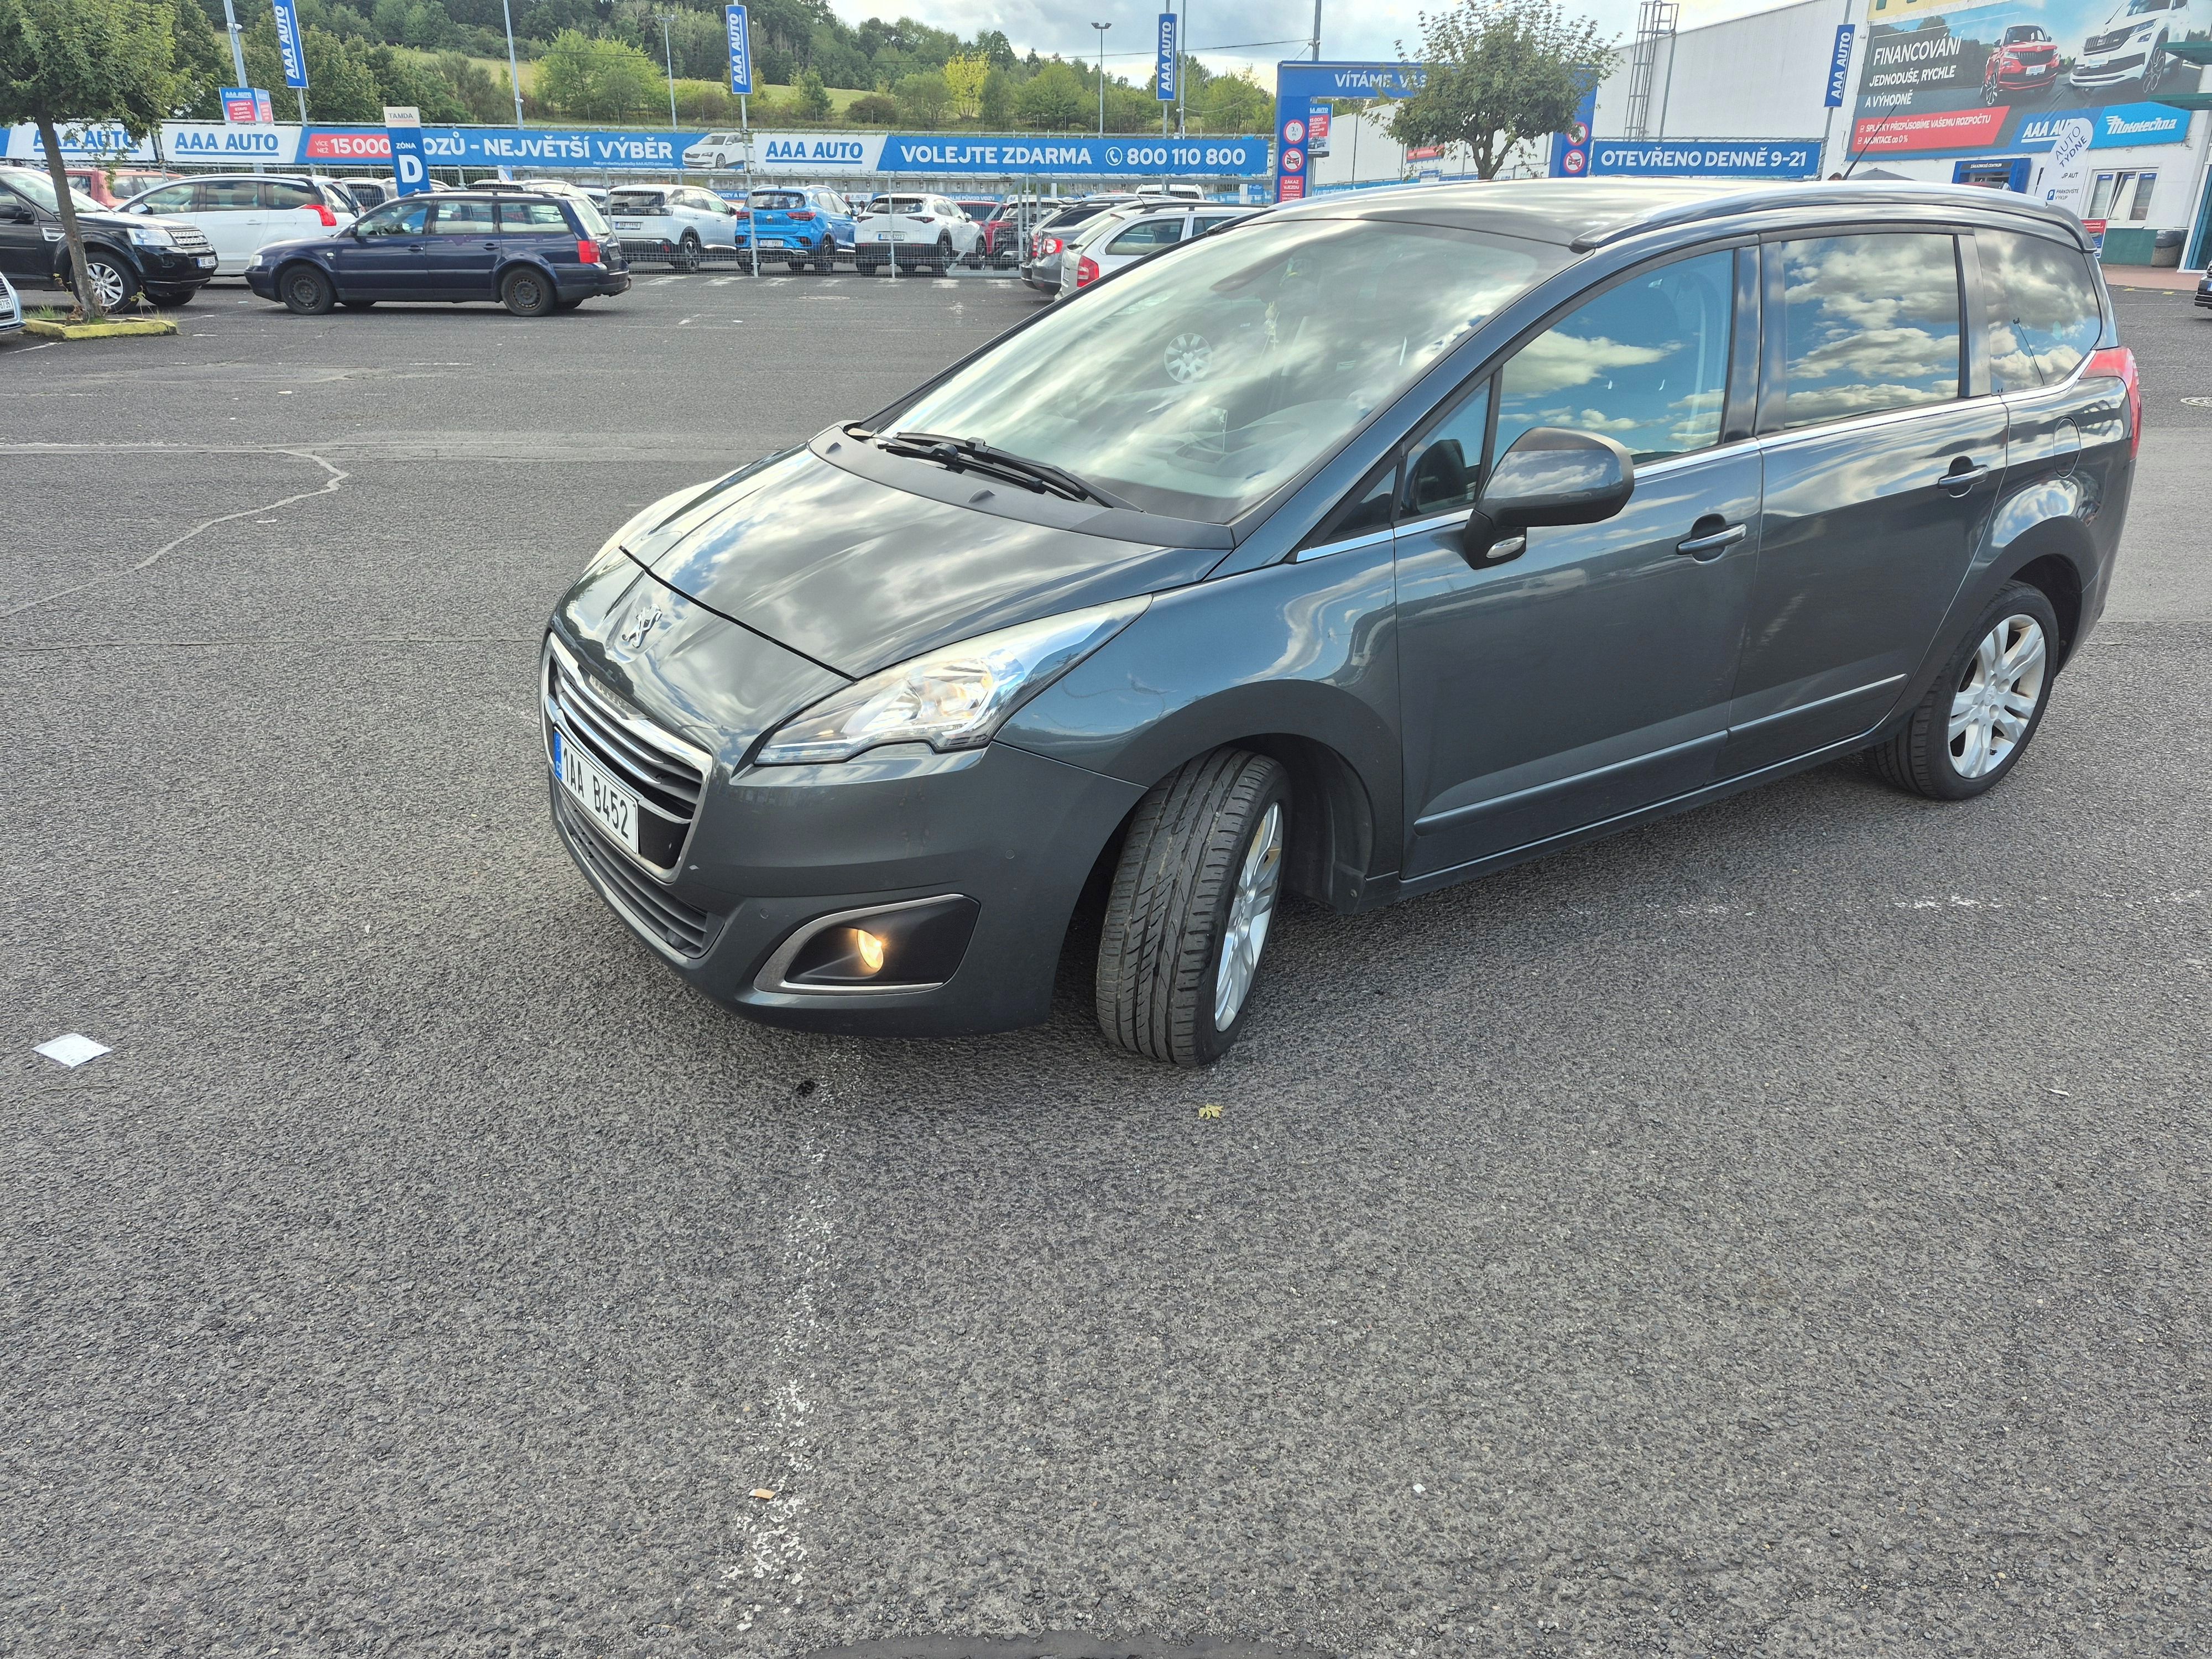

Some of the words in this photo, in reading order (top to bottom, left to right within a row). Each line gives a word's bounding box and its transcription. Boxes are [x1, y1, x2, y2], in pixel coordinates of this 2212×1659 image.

[275, 6, 290, 44] AUTO
[729, 13, 741, 51] AUTO
[1162, 22, 1171, 58] AUTO
[1837, 32, 1850, 67] AUTO
[283, 48, 296, 79] AAA
[732, 55, 744, 85] AAA
[1161, 62, 1171, 91] AAA
[1869, 67, 1919, 87] JEDNODUŠE,
[1921, 65, 1957, 81] RYCHLE
[1334, 71, 1392, 88] VÍTÁME
[1832, 71, 1844, 98] AAA
[1865, 96, 1871, 108] A
[1873, 89, 1913, 107] VÝHODNĚ
[1931, 117, 1956, 128] VAŠEMU
[1956, 113, 1991, 126] ROZPOČTU
[2022, 120, 2049, 138] AAA
[2106, 116, 2177, 135] Mototechna
[175, 132, 218, 150] AAA
[225, 133, 279, 151] AUTO
[422, 131, 465, 155] OZŮ
[484, 135, 590, 158] NEJVĚTŠÍ
[597, 137, 673, 159] VÝBĚR
[766, 142, 807, 157] AAA
[813, 142, 863, 159] AUTO
[900, 145, 998, 164] VOLEJTE
[1002, 147, 1092, 165] ZDARMA
[1128, 147, 1167, 165] 800
[1172, 148, 1202, 165] 110
[1205, 148, 1246, 165] 800
[2055, 126, 2080, 160] AUTO
[2059, 135, 2087, 168] TÝDNE
[398, 154, 423, 183] D
[1601, 147, 1702, 166] OTEVŘENO
[1705, 147, 1767, 166] DENNĚ
[1771, 150, 1806, 166] 9-21
[564, 747, 585, 799] 1AA
[593, 774, 629, 840] B452
